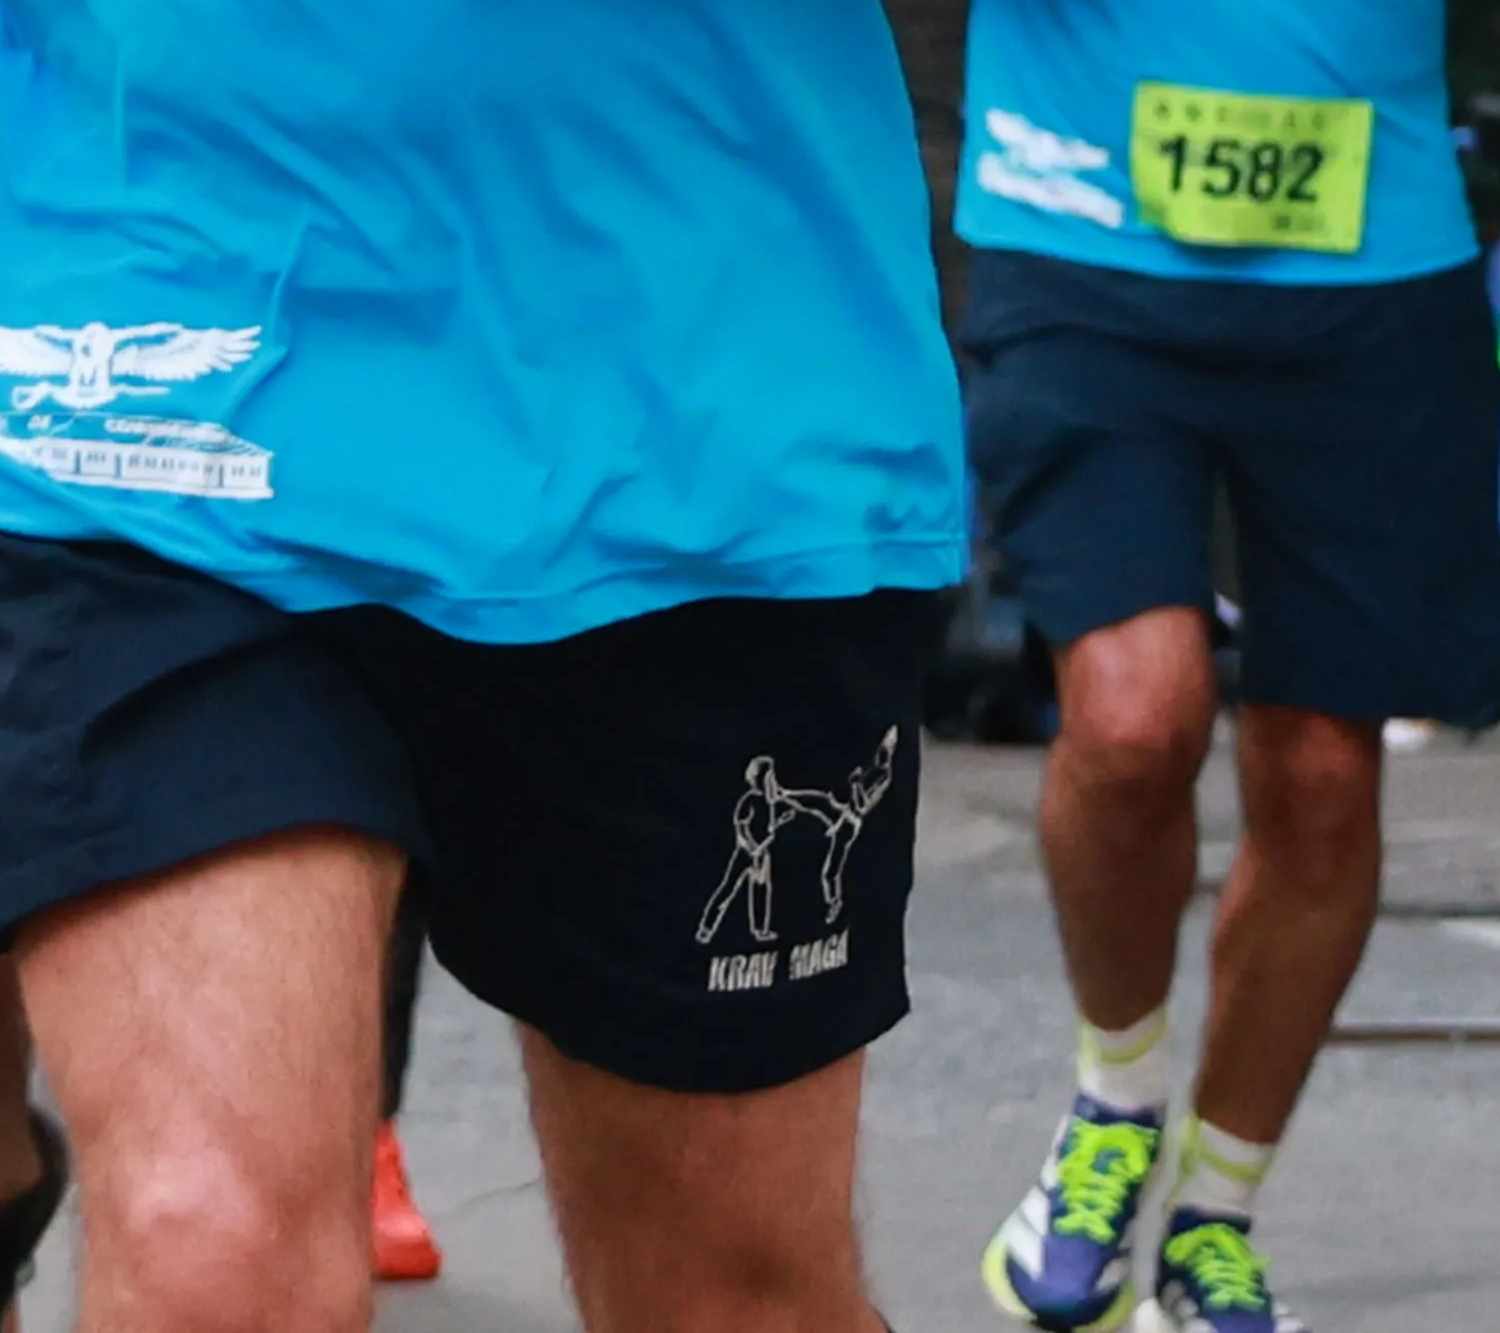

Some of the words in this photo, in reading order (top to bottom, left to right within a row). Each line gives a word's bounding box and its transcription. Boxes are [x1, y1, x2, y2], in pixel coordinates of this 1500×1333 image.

[1160, 134, 1326, 203] 1582
[707, 950, 779, 992] KRAV
[788, 929, 849, 980] MAGA
